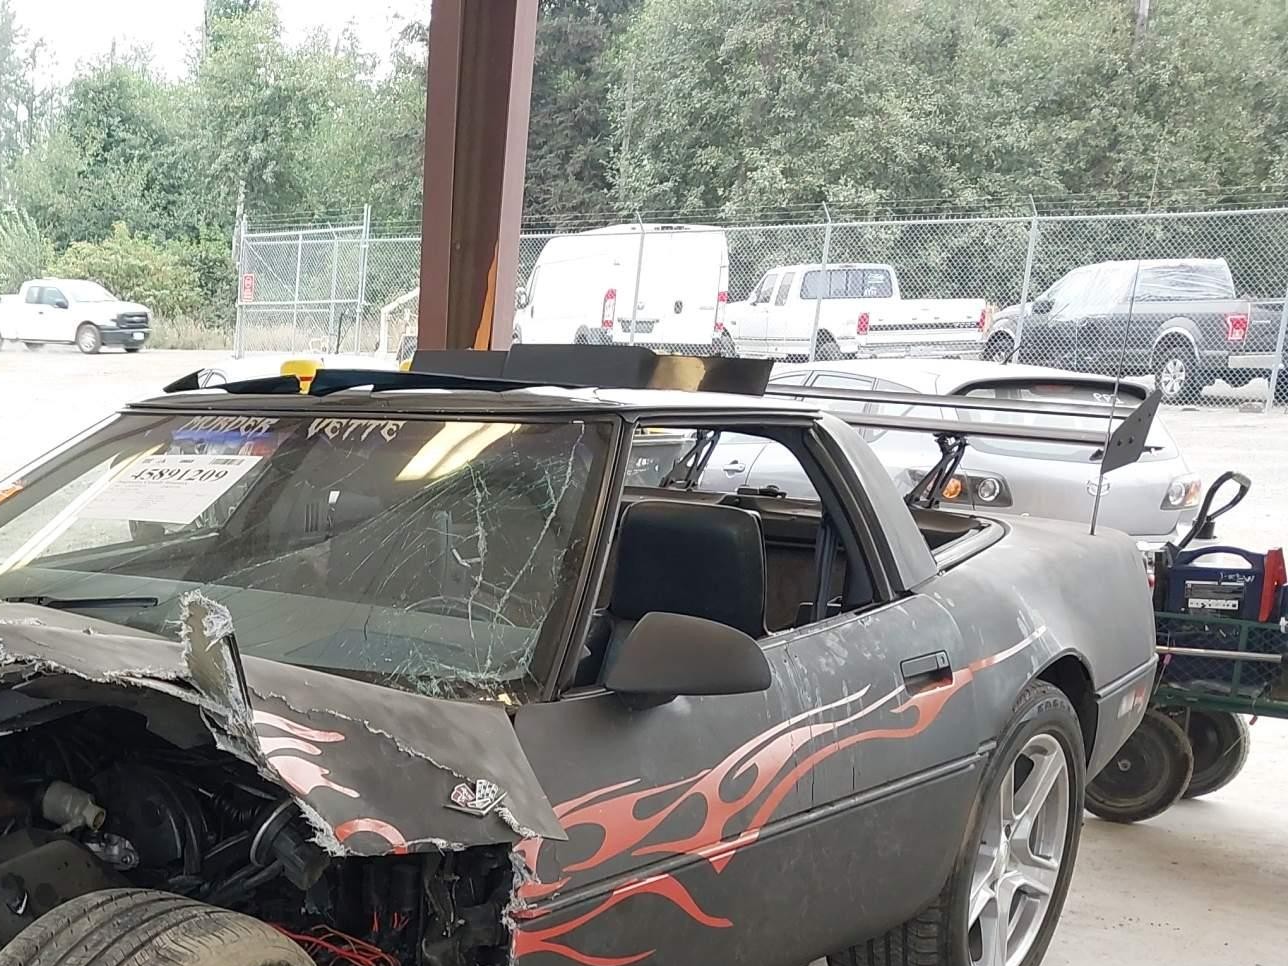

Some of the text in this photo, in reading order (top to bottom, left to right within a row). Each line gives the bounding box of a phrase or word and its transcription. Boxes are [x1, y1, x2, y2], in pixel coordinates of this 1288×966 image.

[175, 415, 407, 442] MURDER VETTE
[130, 468, 229, 483] 45891209
